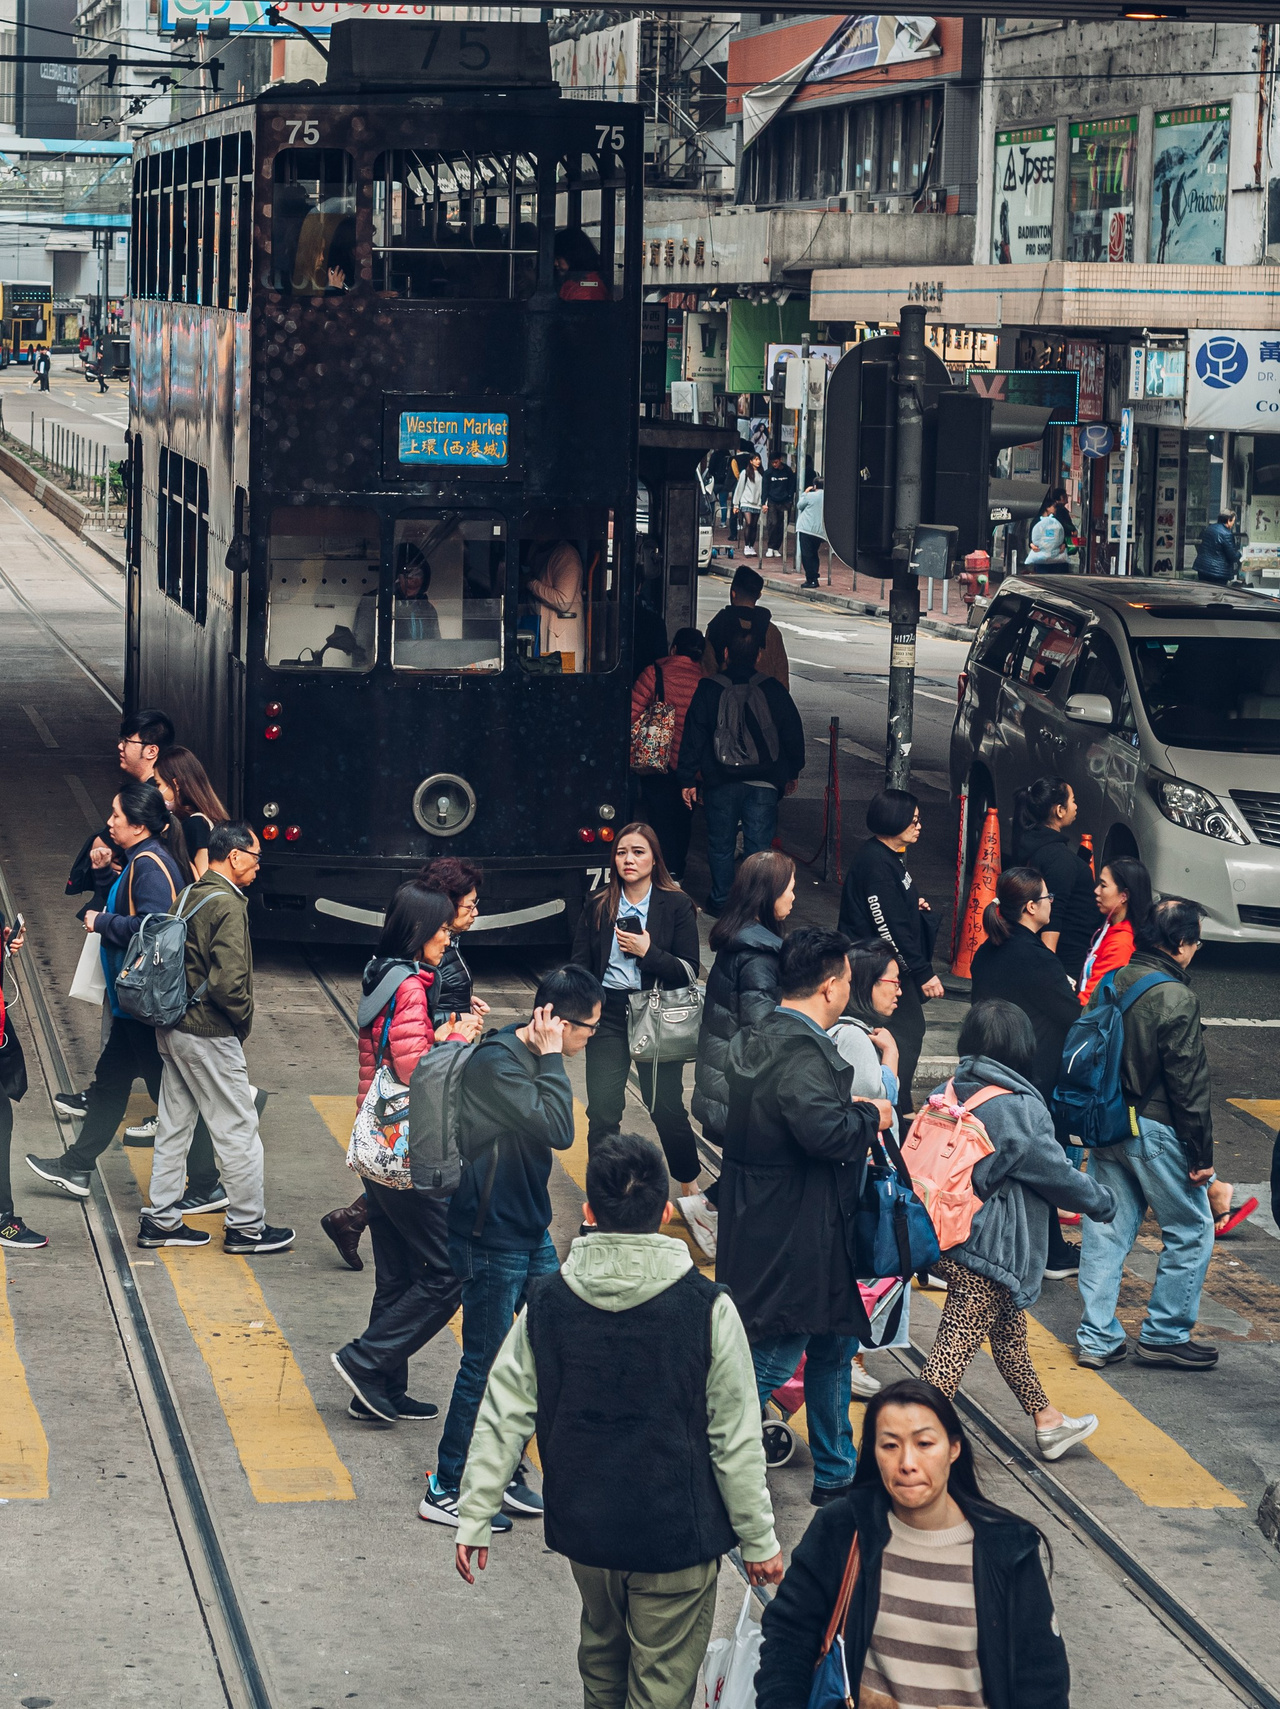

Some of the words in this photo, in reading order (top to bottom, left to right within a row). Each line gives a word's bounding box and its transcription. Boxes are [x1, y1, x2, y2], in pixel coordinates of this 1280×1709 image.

[410, 25, 491, 71] 75
[285, 120, 320, 145] 75
[595, 125, 625, 150] 75
[1018, 225, 1052, 239] BADMINTON
[1025, 243, 1036, 255] PRO
[1037, 243, 1052, 255] SHOP
[1257, 371, 1277, 382] DR.
[406, 416, 458, 434] Western
[463, 417, 508, 435] Market
[404, 438, 507, 459] 上環(西港城)
[867, 895, 885, 925] GOOD
